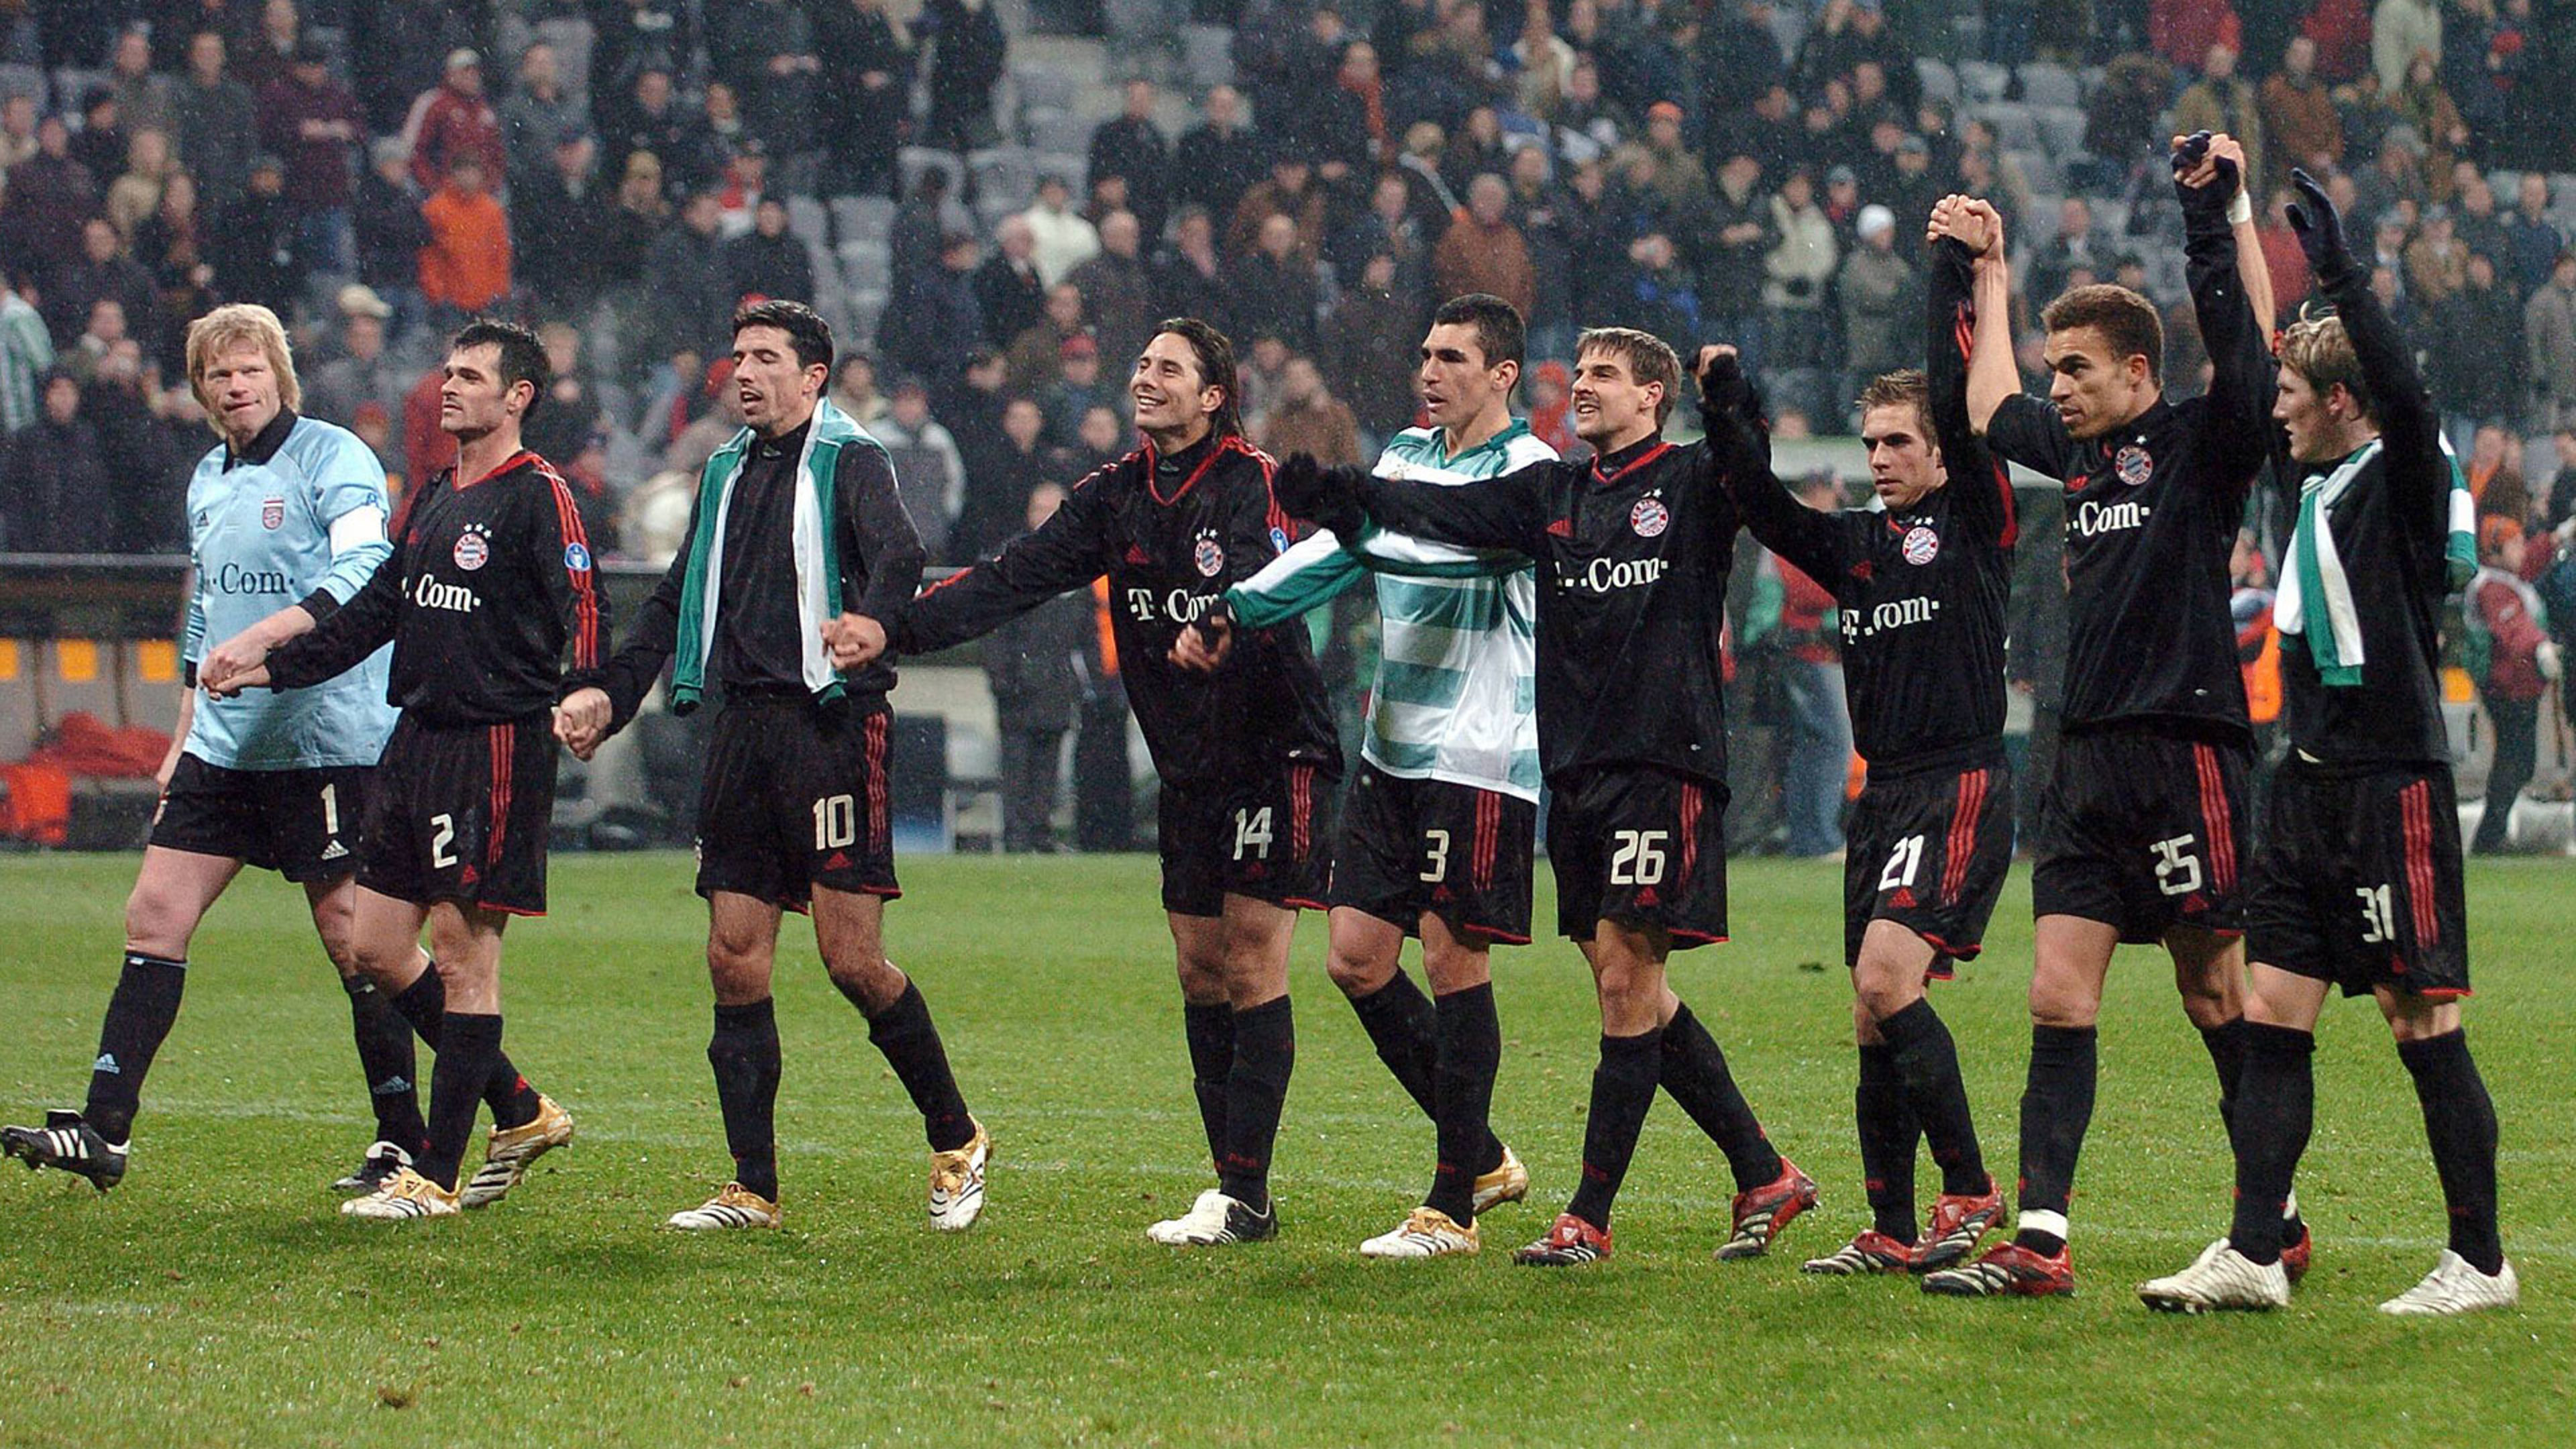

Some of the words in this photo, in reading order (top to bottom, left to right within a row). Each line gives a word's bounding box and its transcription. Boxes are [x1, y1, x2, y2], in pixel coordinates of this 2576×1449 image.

[321, 783, 338, 835] 1
[813, 794, 855, 851] 10
[1233, 807, 1273, 861] 14
[431, 813, 458, 869] 2
[1420, 830, 1450, 882] 3
[1611, 830, 1668, 885] 26
[1878, 835, 1925, 892] 21
[2149, 833, 2202, 896] 25
[2355, 883, 2395, 943] 31
